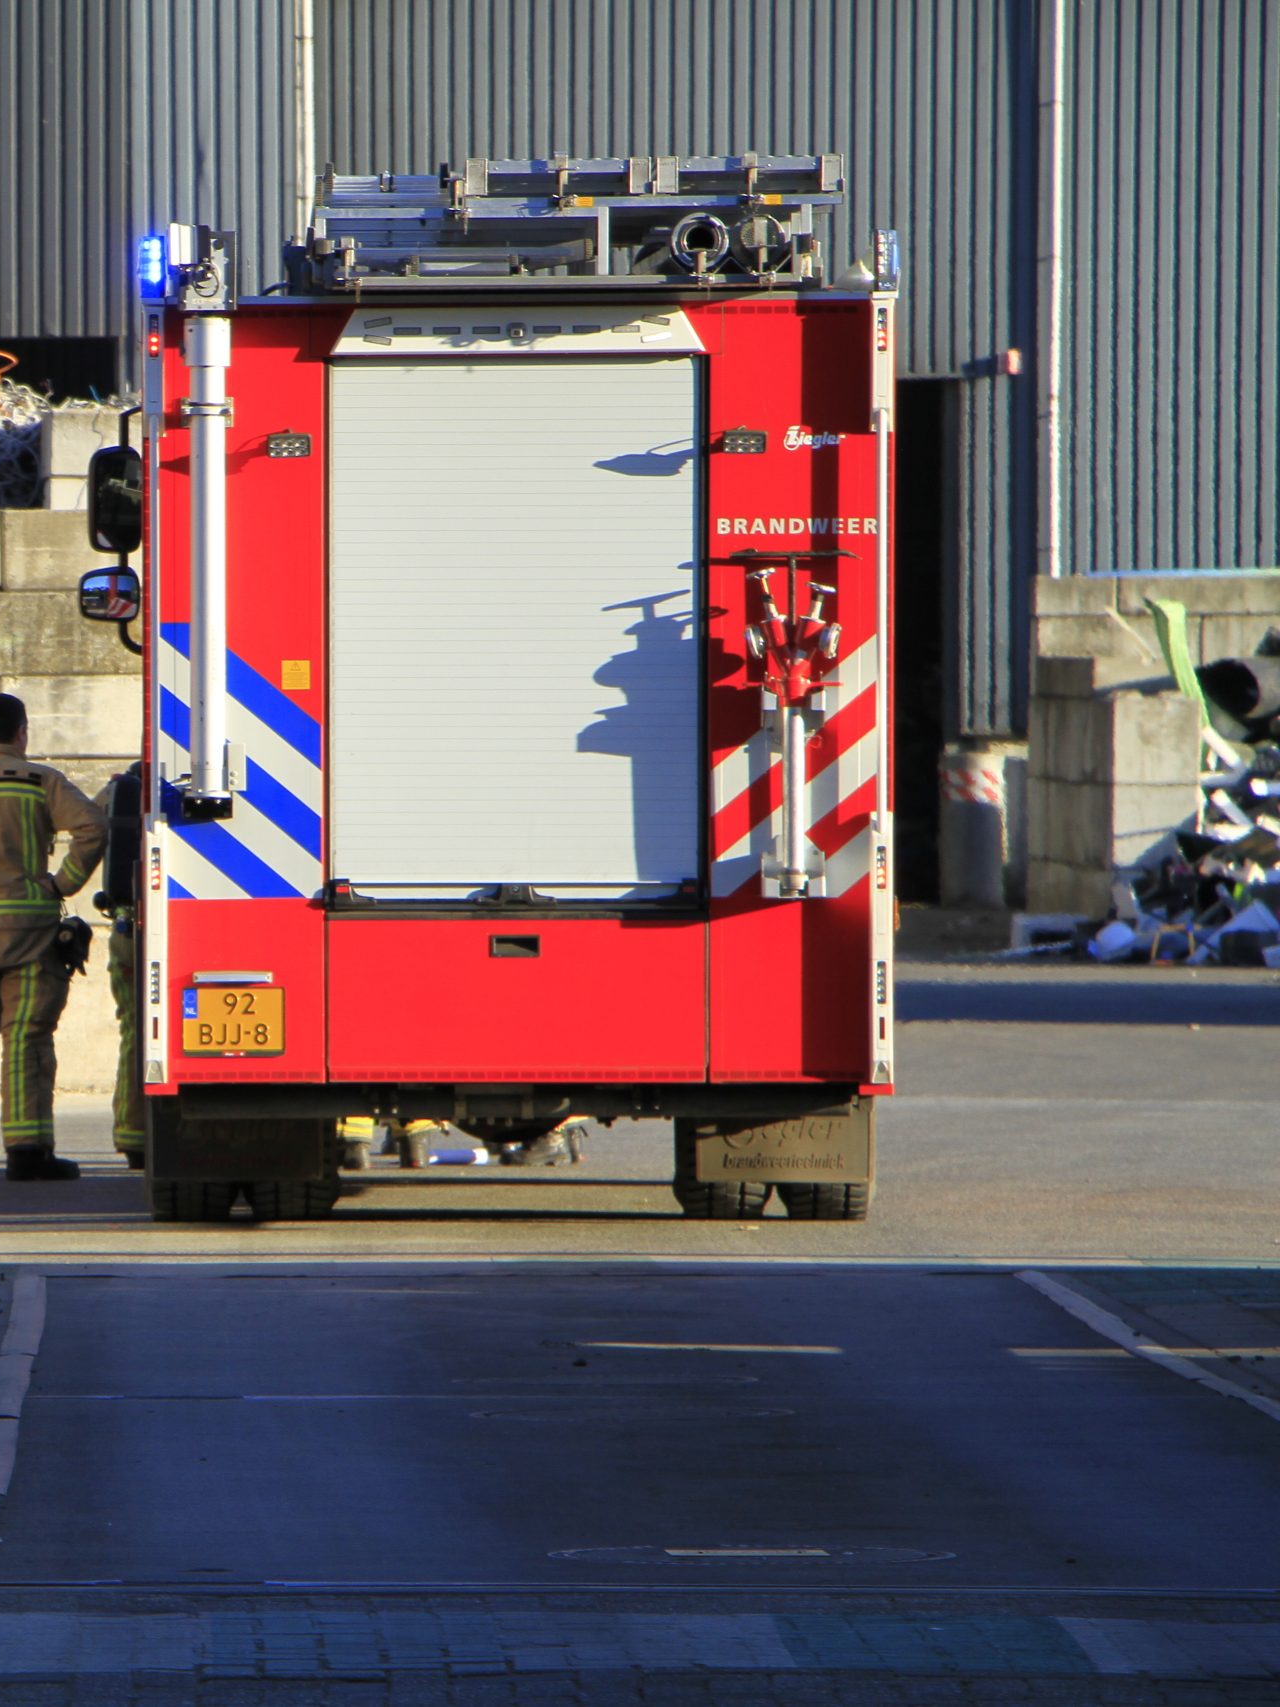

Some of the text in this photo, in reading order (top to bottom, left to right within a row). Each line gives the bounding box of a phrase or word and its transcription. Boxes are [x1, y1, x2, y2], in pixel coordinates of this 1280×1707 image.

[783, 425, 847, 451] Ziegler
[716, 517, 879, 535] BRANDWEER
[184, 1007, 197, 1015] NL
[223, 992, 256, 1015] 92
[199, 1023, 269, 1046] BJJ-8
